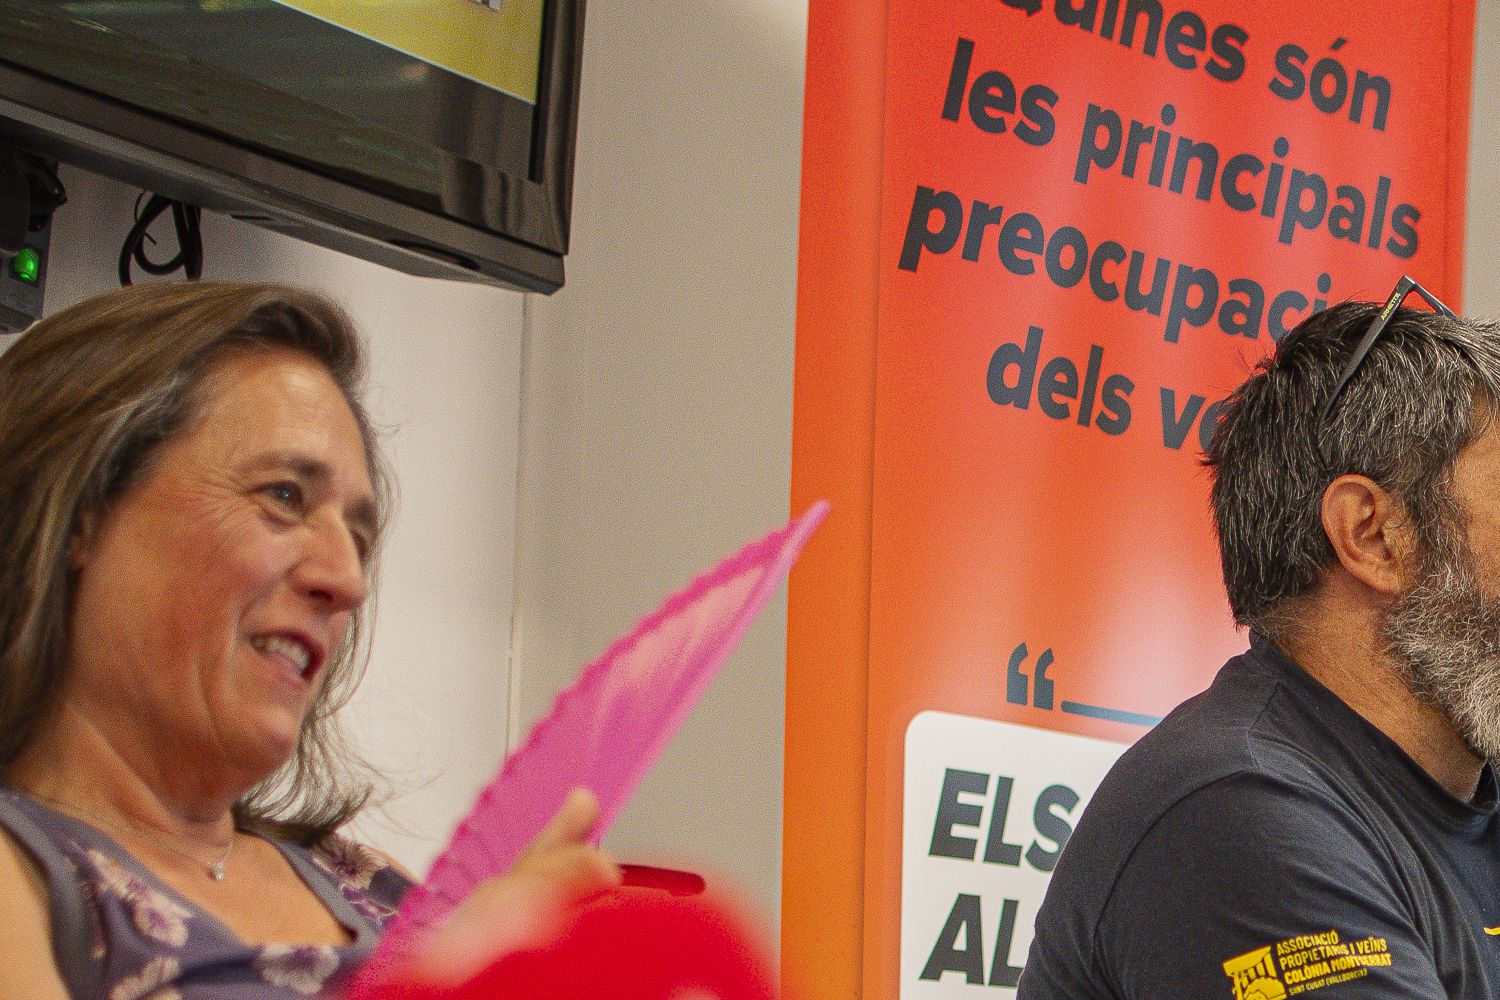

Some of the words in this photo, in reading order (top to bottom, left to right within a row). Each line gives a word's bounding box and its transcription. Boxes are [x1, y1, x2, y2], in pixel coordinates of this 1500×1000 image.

[1268, 37, 1392, 132] són
[941, 37, 1060, 147] les
[1073, 103, 1423, 260] principals
[986, 325, 1136, 437] dels
[928, 767, 1080, 873] ELS
[1277, 930, 1339, 956] ASSOCIACIÓ
[1279, 944, 1349, 970] PROPIETARIS
